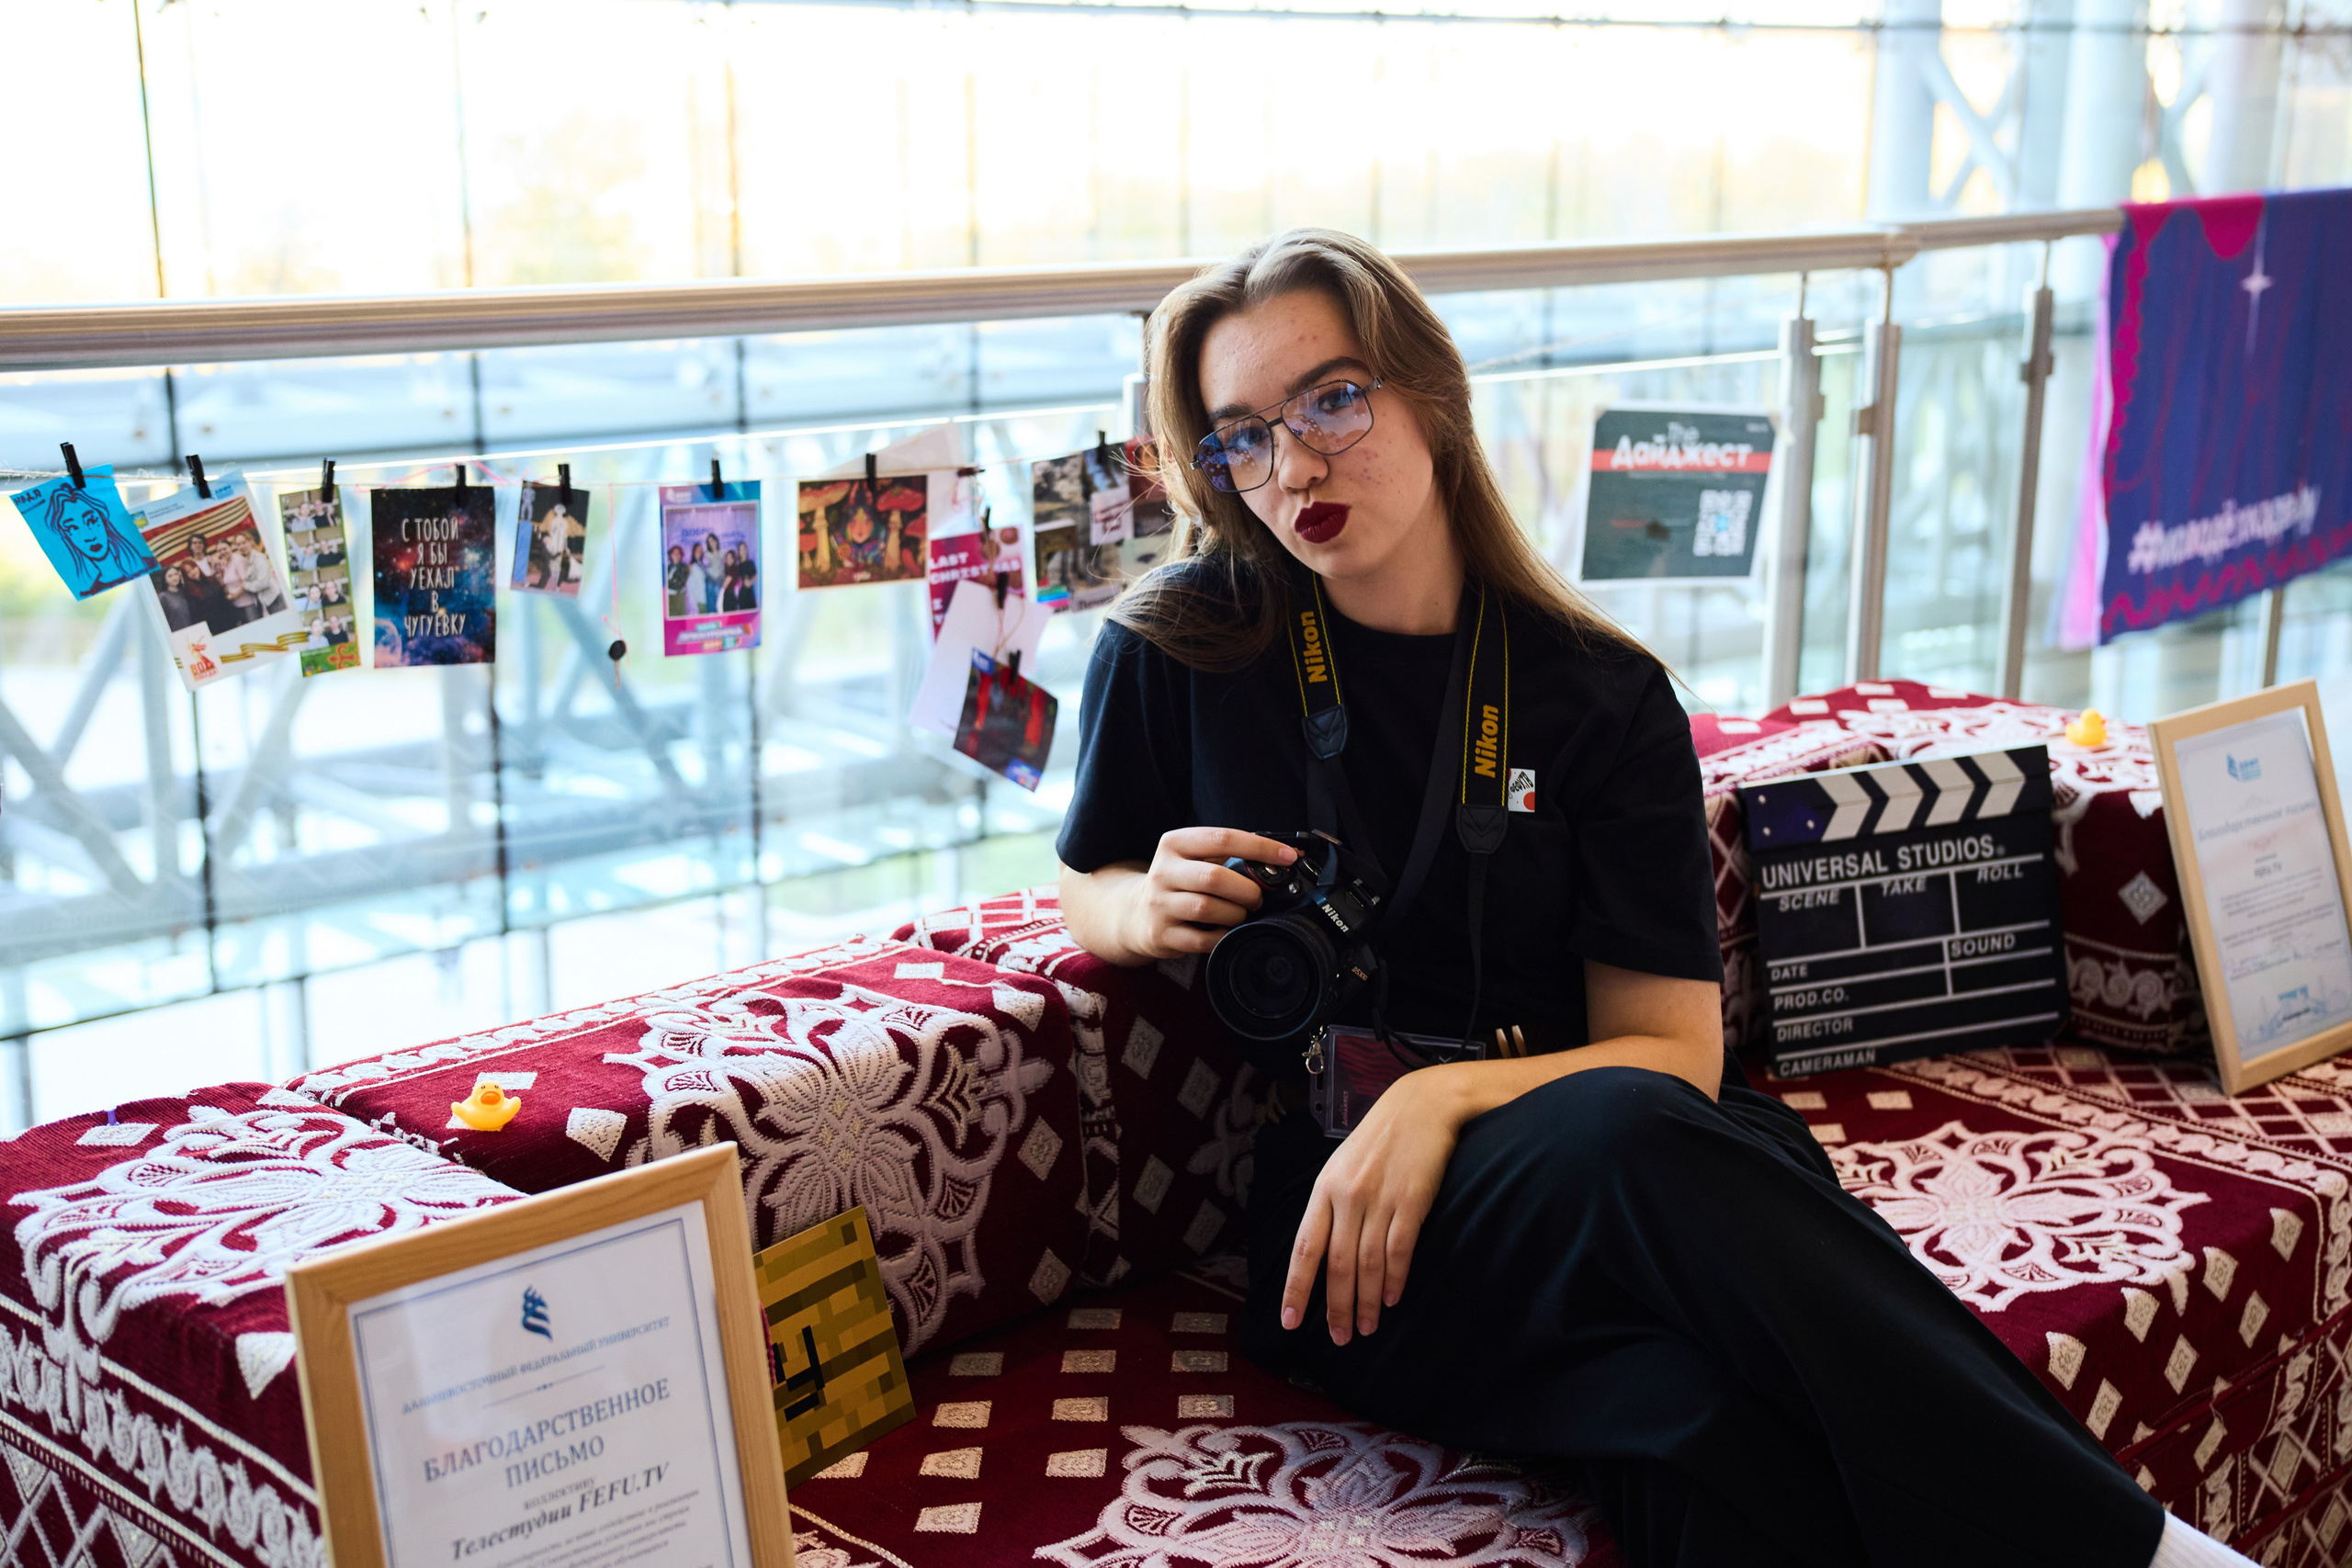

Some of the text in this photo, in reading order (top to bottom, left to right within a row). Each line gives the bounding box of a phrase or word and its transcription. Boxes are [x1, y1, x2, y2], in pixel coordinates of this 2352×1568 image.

[401, 515, 459, 542] С ТОБОЙ
[417, 541, 448, 566] Я БЫ
[928, 551, 968, 570] LAST
[410, 566, 455, 590] УЕХАЛ
[432, 590, 439, 613] В
[404, 613, 467, 637] ЧУГУЕВКУ
[1300, 611, 1329, 683] Nikon
[1475, 705, 1499, 778] Nikon
[1761, 835, 1995, 889] UNIVERSAL STUDIOS
[1977, 863, 2024, 884] ROLL
[1880, 876, 1928, 897] TAKE
[1779, 889, 1840, 912] SCENE
[1321, 903, 1350, 933] Nikon
[1951, 933, 2016, 957] SOUND
[1770, 964, 1808, 982] DATE
[1773, 987, 1850, 1011] PROD.CO.
[1777, 1017, 1853, 1043] DIRECTOR
[1779, 1049, 1877, 1078] CAMERAMAN
[424, 1378, 671, 1483] БЛАГОДАРСТВЕННОЕ
[505, 1435, 605, 1488] ПИСЬМО
[451, 1503, 571, 1561] Телестудии
[578, 1461, 670, 1513] FEFU.TV
